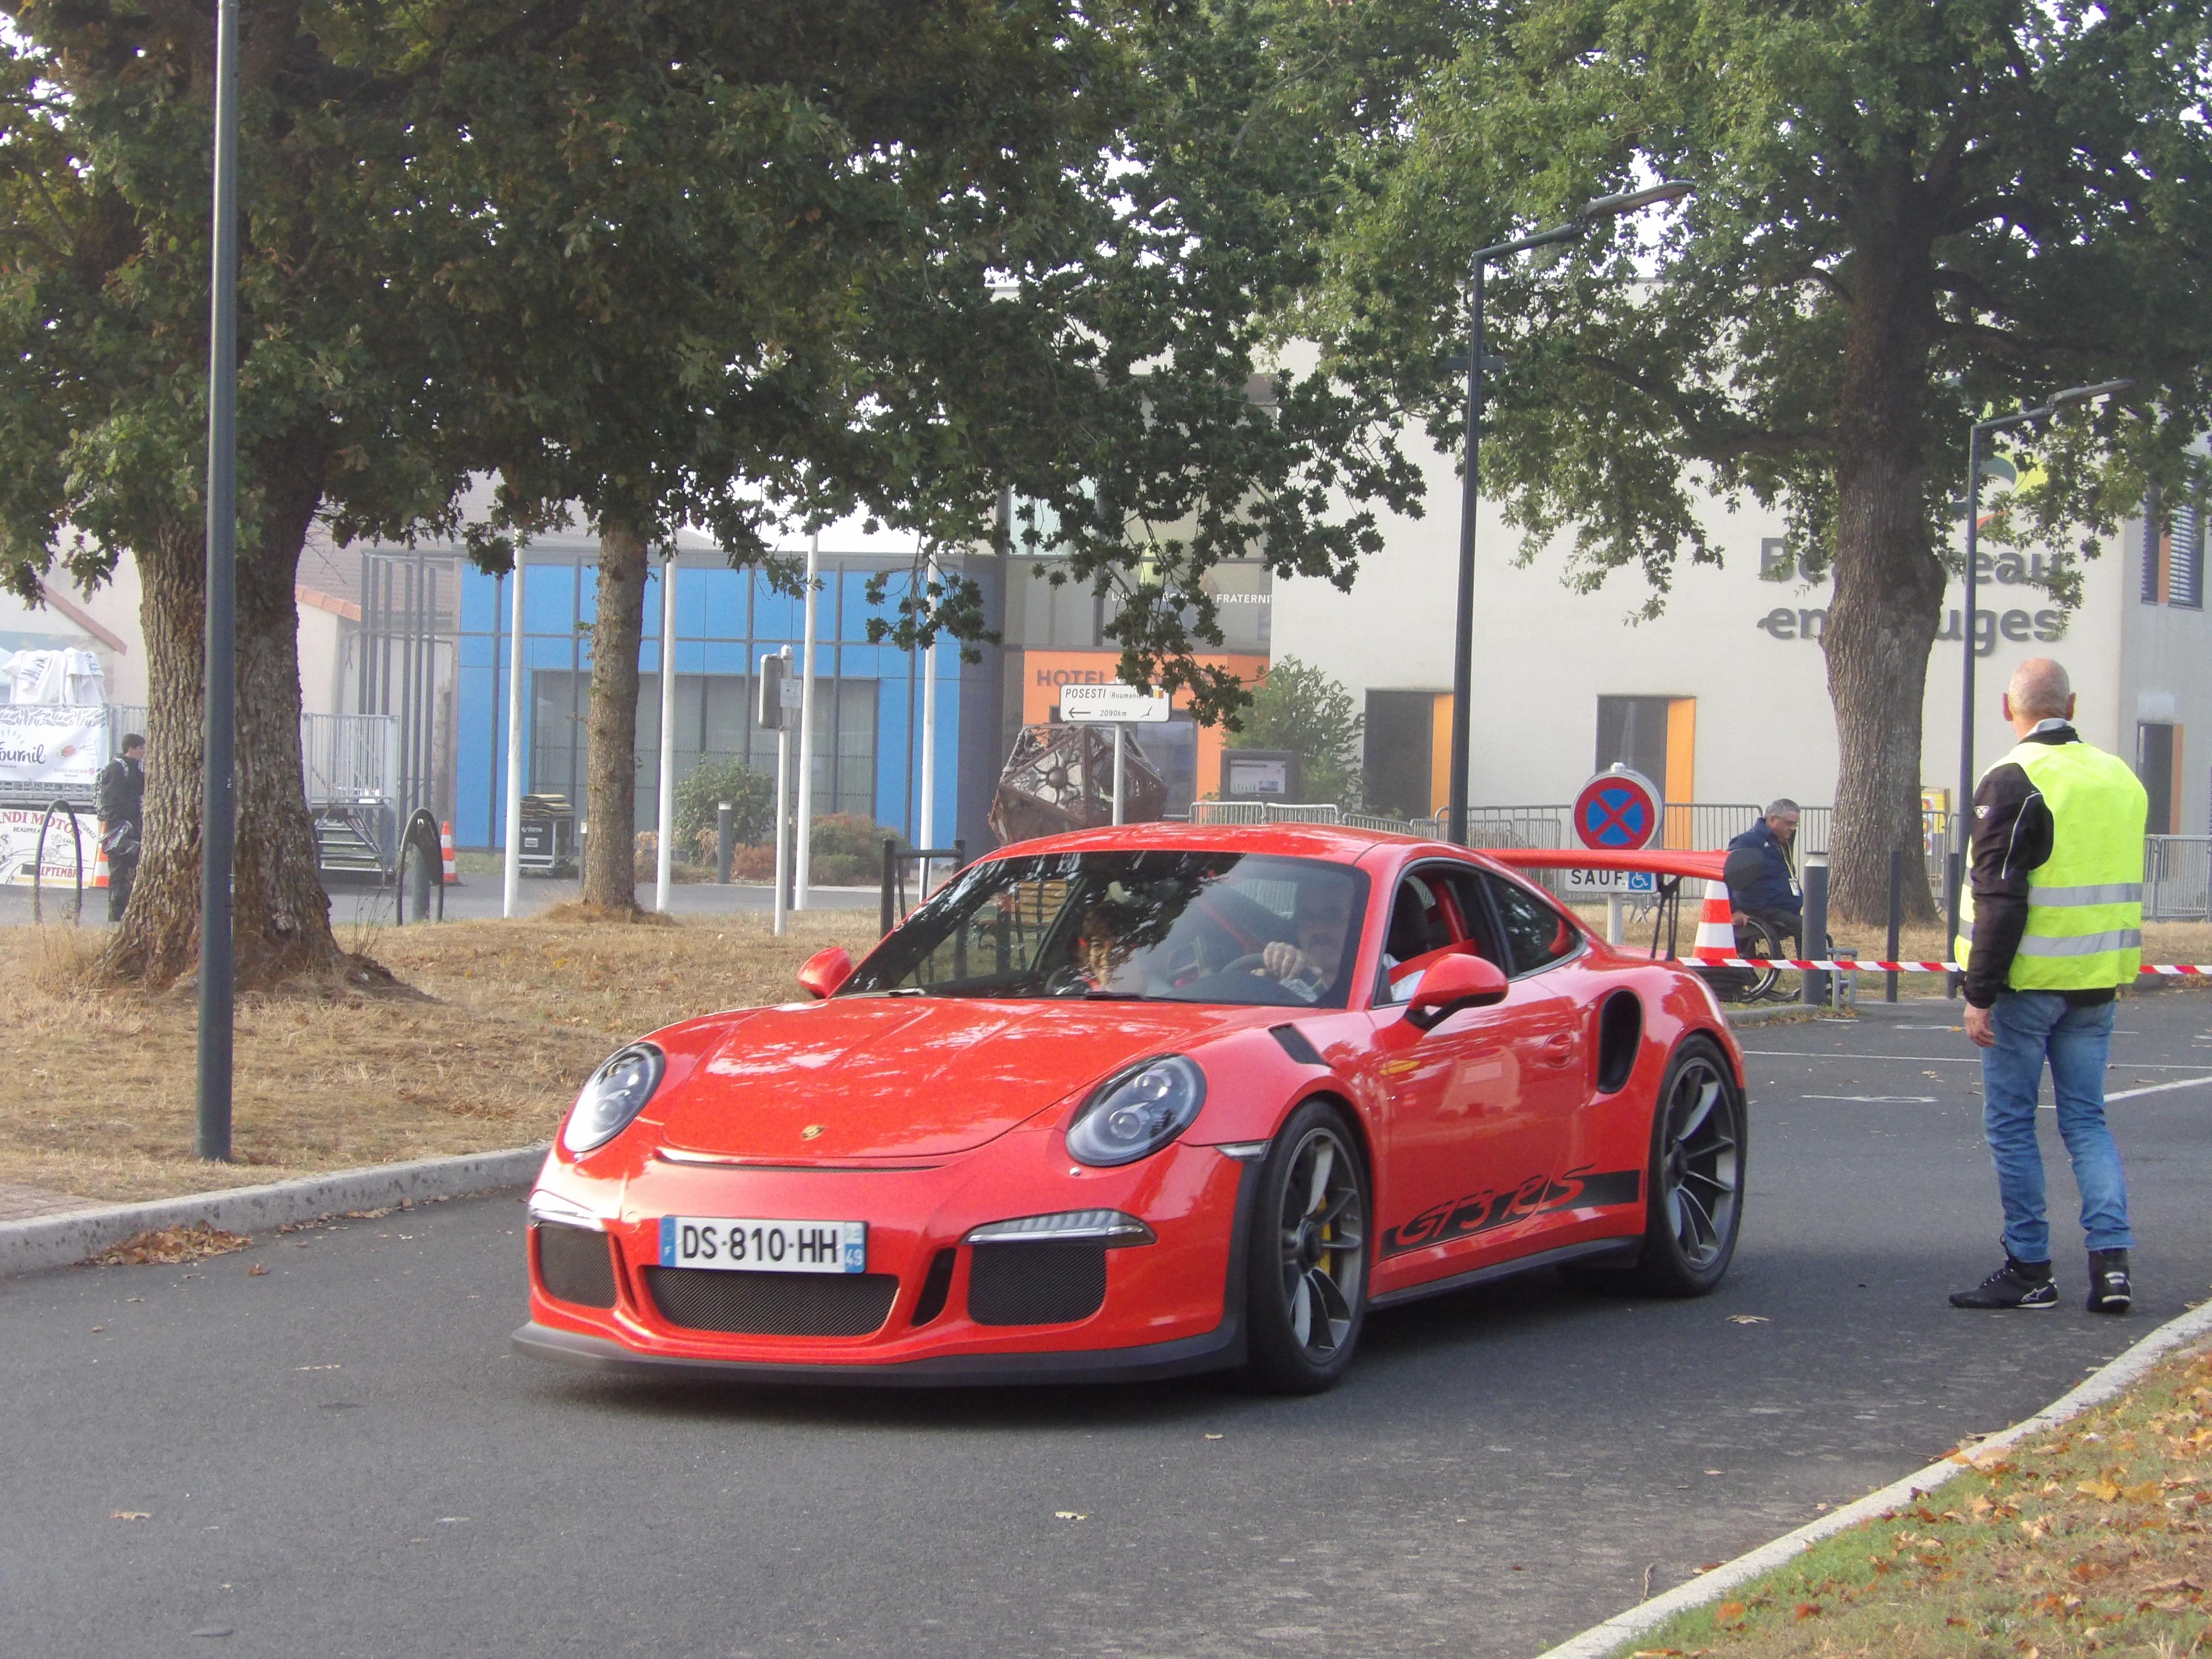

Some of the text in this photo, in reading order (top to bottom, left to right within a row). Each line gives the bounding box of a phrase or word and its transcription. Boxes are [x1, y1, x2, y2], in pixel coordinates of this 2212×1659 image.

[1216, 593, 1272, 603] FRATERNI
[1065, 688, 1106, 699] POSESTI
[0, 811, 27, 824] NDI
[1571, 869, 1623, 885] SAUF
[1395, 1190, 1494, 1246] GT3
[845, 1248, 864, 1266] 49
